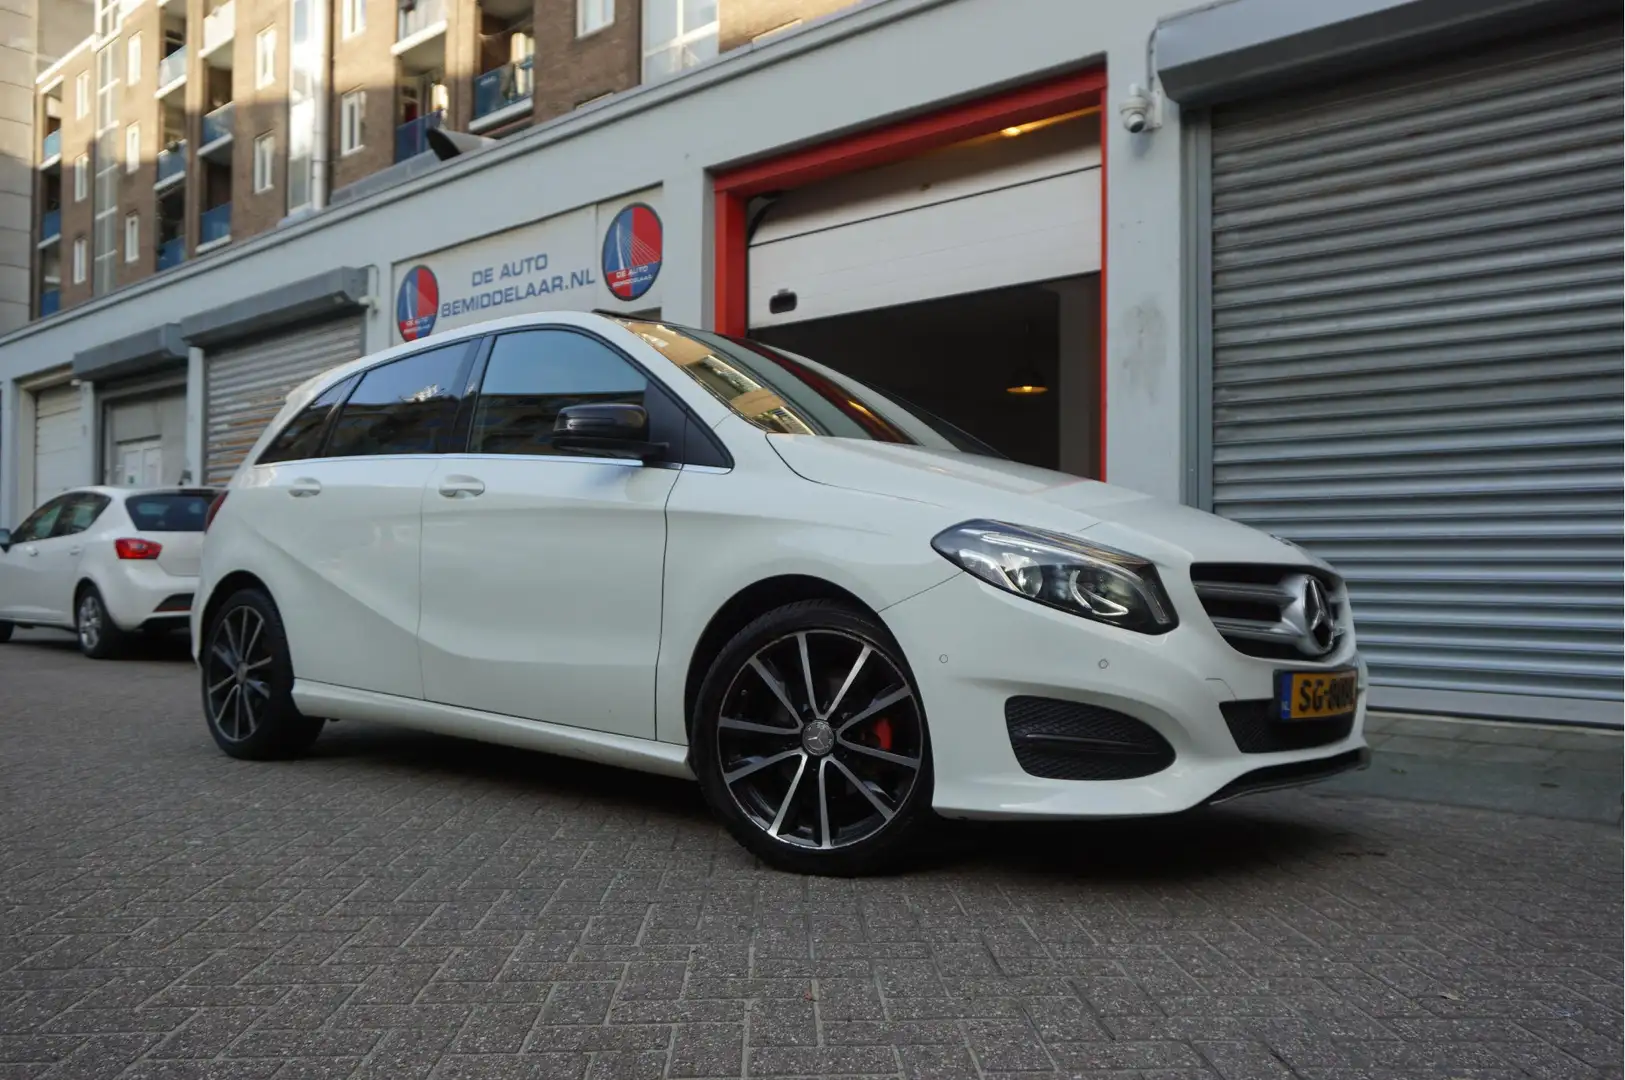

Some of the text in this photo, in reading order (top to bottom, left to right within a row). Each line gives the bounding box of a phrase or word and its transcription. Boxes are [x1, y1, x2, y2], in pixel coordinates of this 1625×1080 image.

[471, 253, 548, 287] DE AUTO
[615, 270, 627, 279] DE
[440, 268, 596, 318] BEMIDDELAAR.NL
